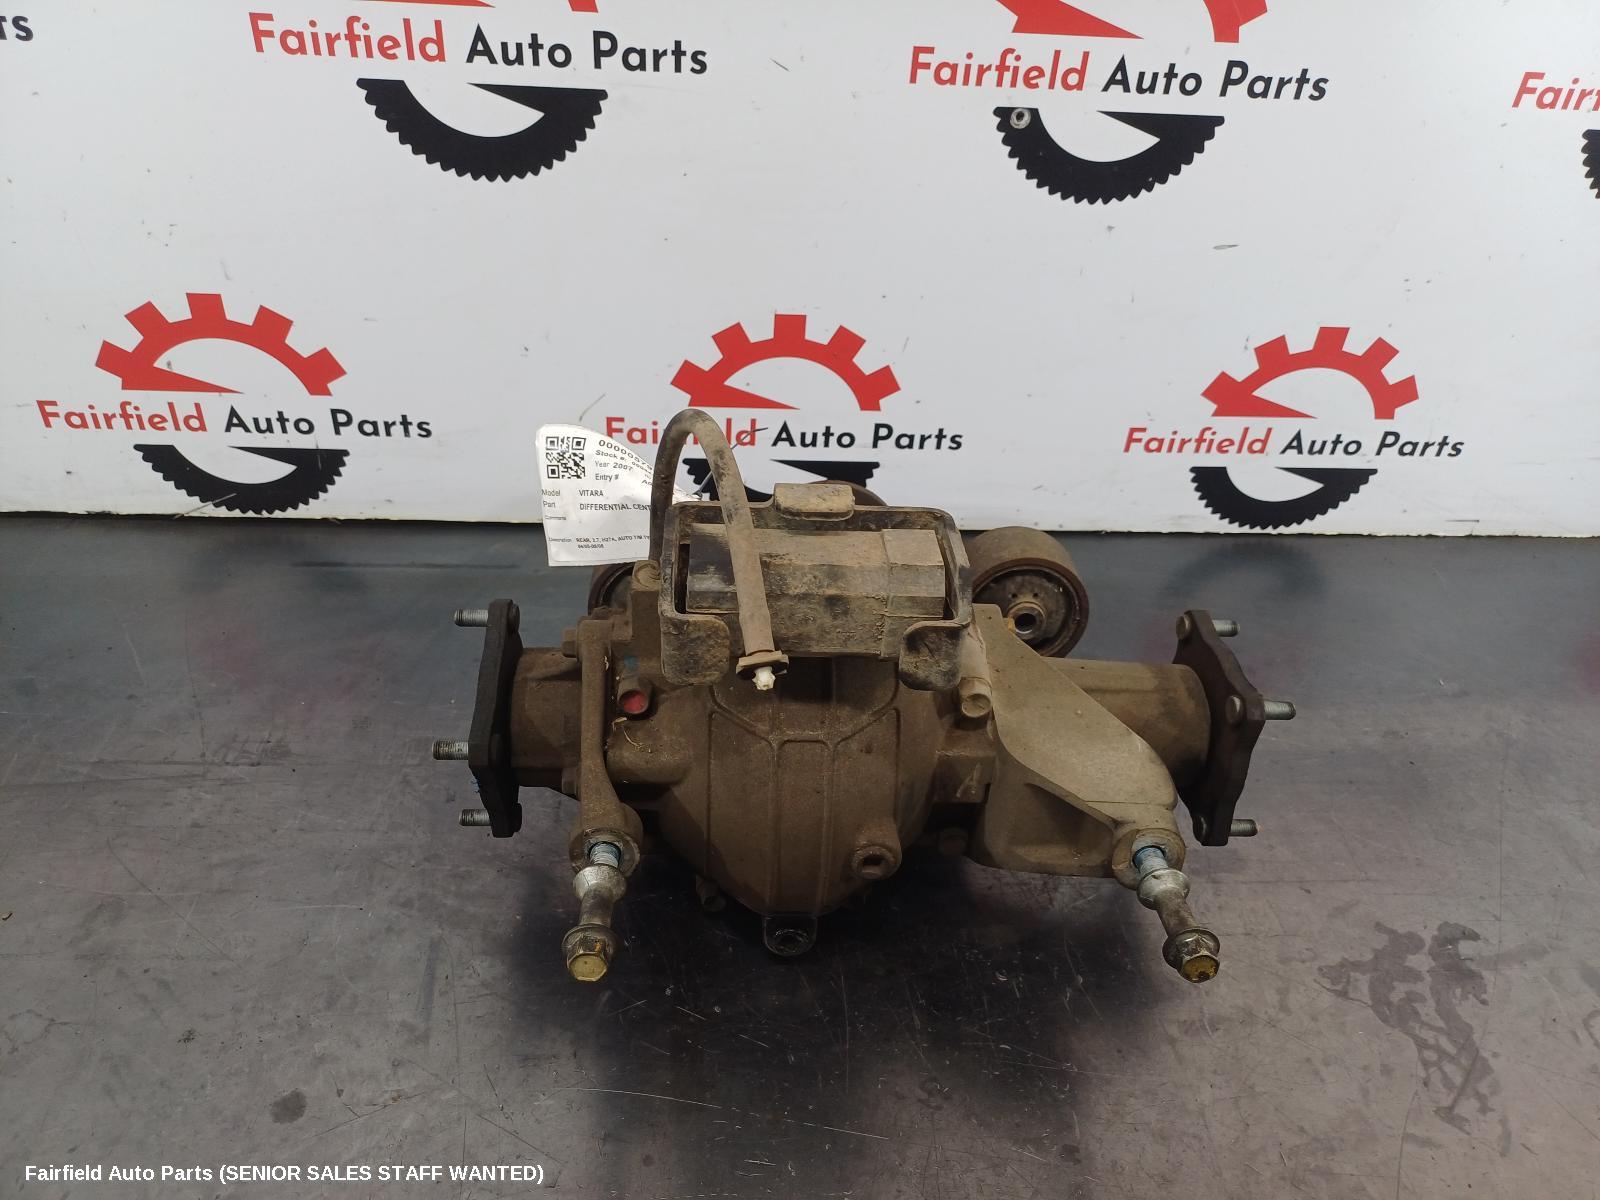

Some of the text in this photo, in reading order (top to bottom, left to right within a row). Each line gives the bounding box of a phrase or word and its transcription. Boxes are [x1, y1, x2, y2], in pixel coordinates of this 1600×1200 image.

[249, 13, 708, 75] Fairfield Auto Parts
[910, 46, 1331, 101] Fairfield Auto Parts
[37, 400, 433, 439] Fairfield Auto Parts
[771, 421, 857, 449] Auto
[871, 423, 964, 451] Parts
[1123, 427, 1466, 457] Fairfield Auto Parts
[595, 449, 619, 460] Stock
[594, 459, 634, 472] Year 2007
[595, 473, 613, 482] Entry
[541, 488, 604, 497] Model VITARA
[543, 500, 556, 509] Part
[579, 503, 632, 511] DIFFERENTIAL
